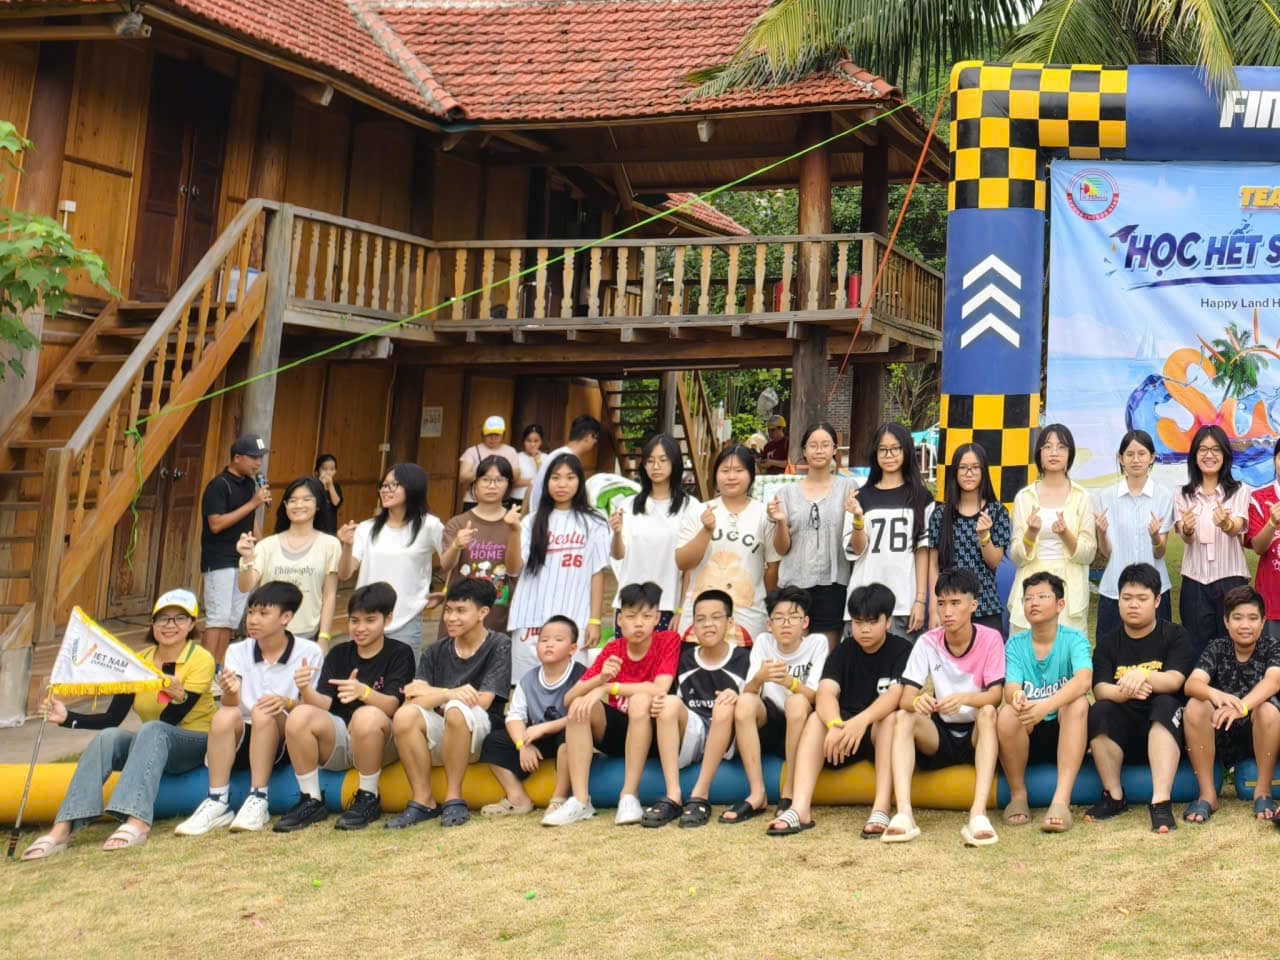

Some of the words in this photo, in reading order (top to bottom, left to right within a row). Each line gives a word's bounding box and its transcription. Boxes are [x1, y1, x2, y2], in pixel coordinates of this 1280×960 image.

[1125, 232, 1201, 277] HỌC
[1204, 223, 1263, 265] HẾT
[1200, 298, 1237, 313] Happy
[1241, 298, 1269, 308] Land
[711, 528, 762, 554] UCCI
[871, 517, 908, 553] 76
[470, 550, 504, 560] HOME
[561, 553, 583, 568] 26
